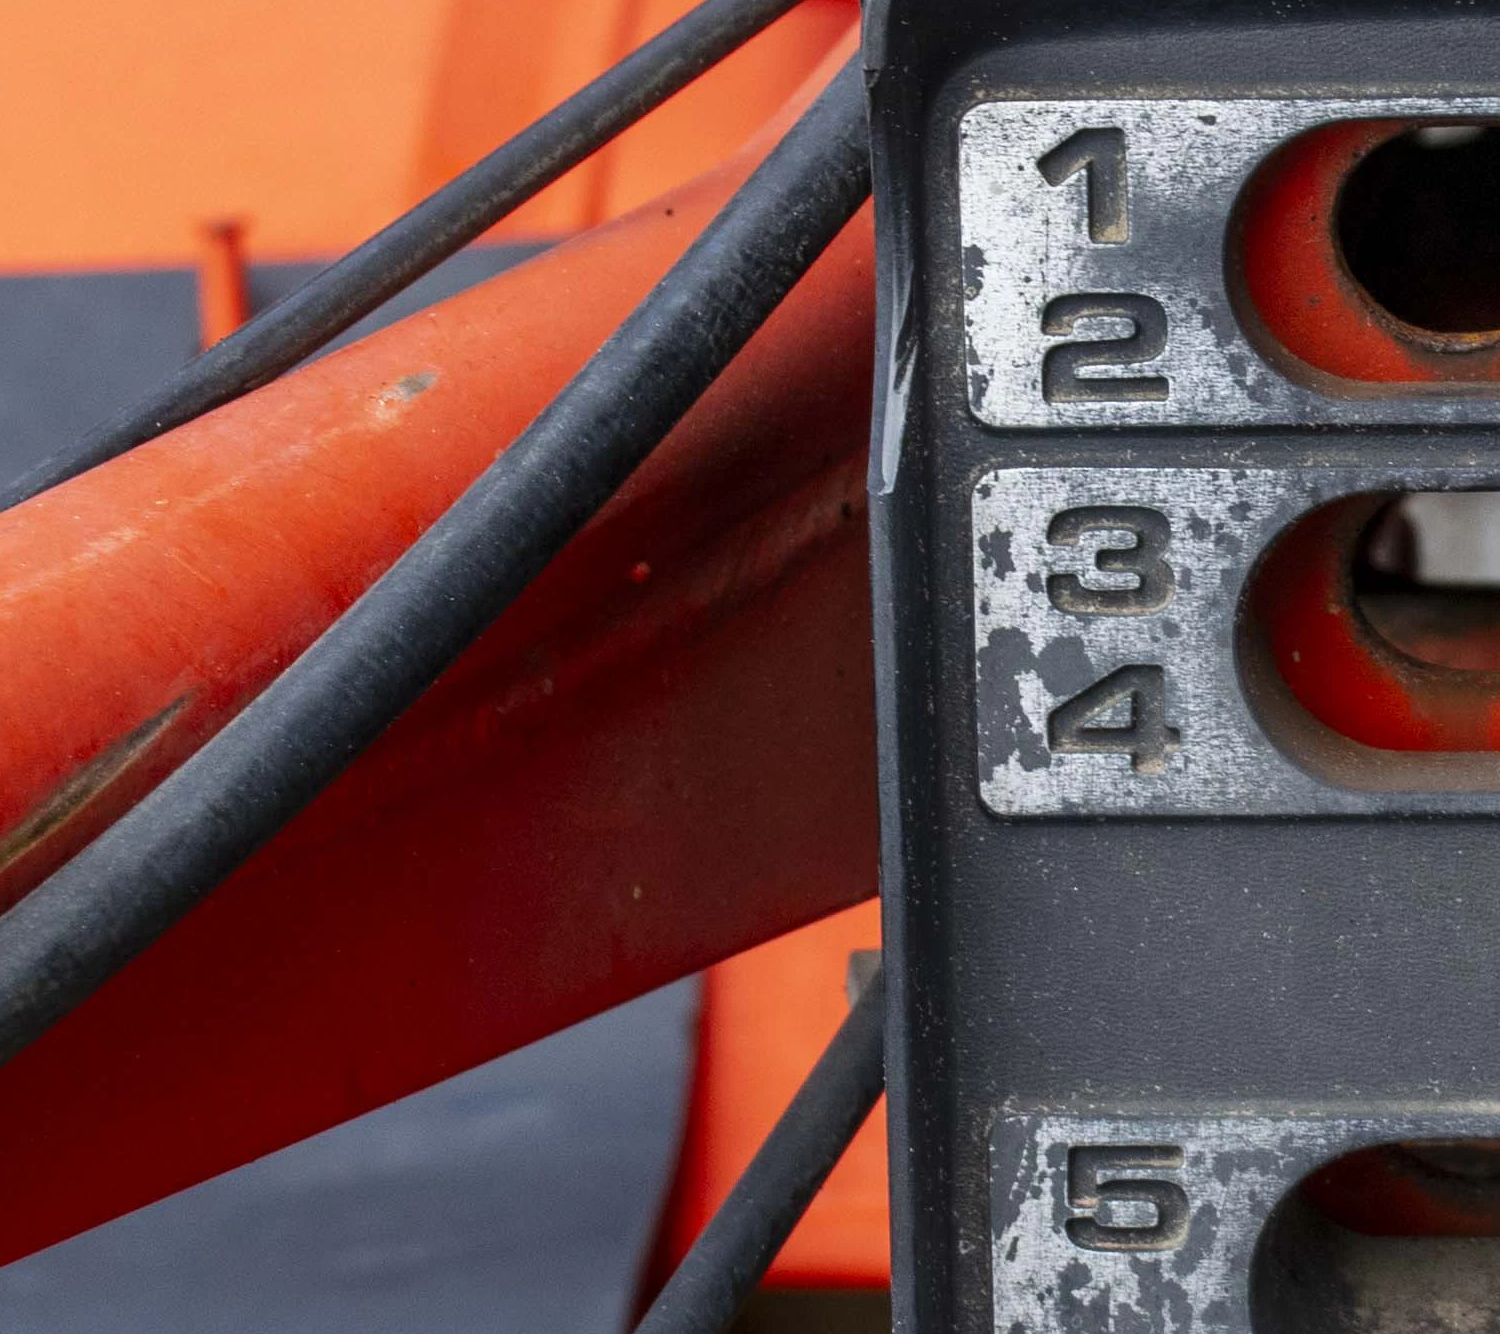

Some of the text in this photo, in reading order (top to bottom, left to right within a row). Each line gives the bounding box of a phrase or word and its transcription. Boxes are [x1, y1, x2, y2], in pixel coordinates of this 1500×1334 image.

[1036, 126, 1129, 245] 1
[1041, 293, 1169, 403] 2
[1047, 505, 1174, 616] 3
[1047, 665, 1181, 775] 4
[1066, 1145, 1189, 1251] 5
